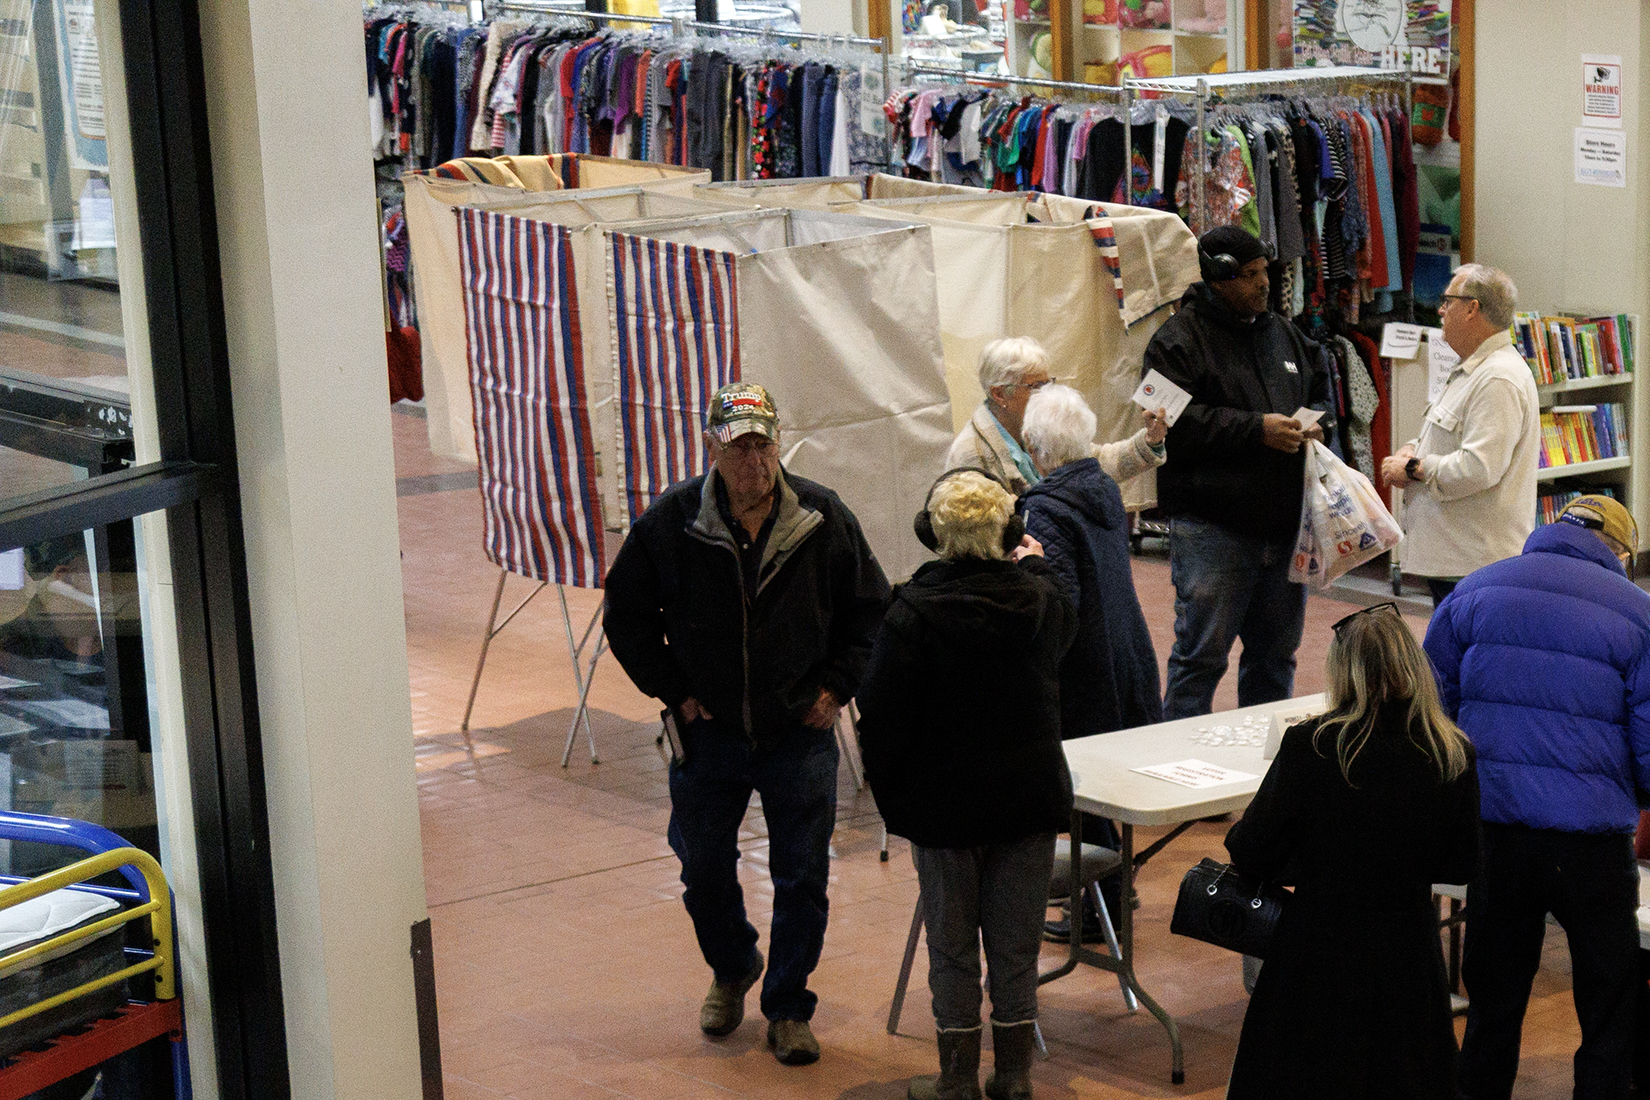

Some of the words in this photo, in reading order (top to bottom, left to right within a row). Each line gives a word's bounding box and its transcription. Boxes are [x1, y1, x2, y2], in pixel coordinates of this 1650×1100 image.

[1380, 45, 1442, 73] HERE
[1585, 84, 1619, 95] WARNING
[721, 392, 761, 403] Trump
